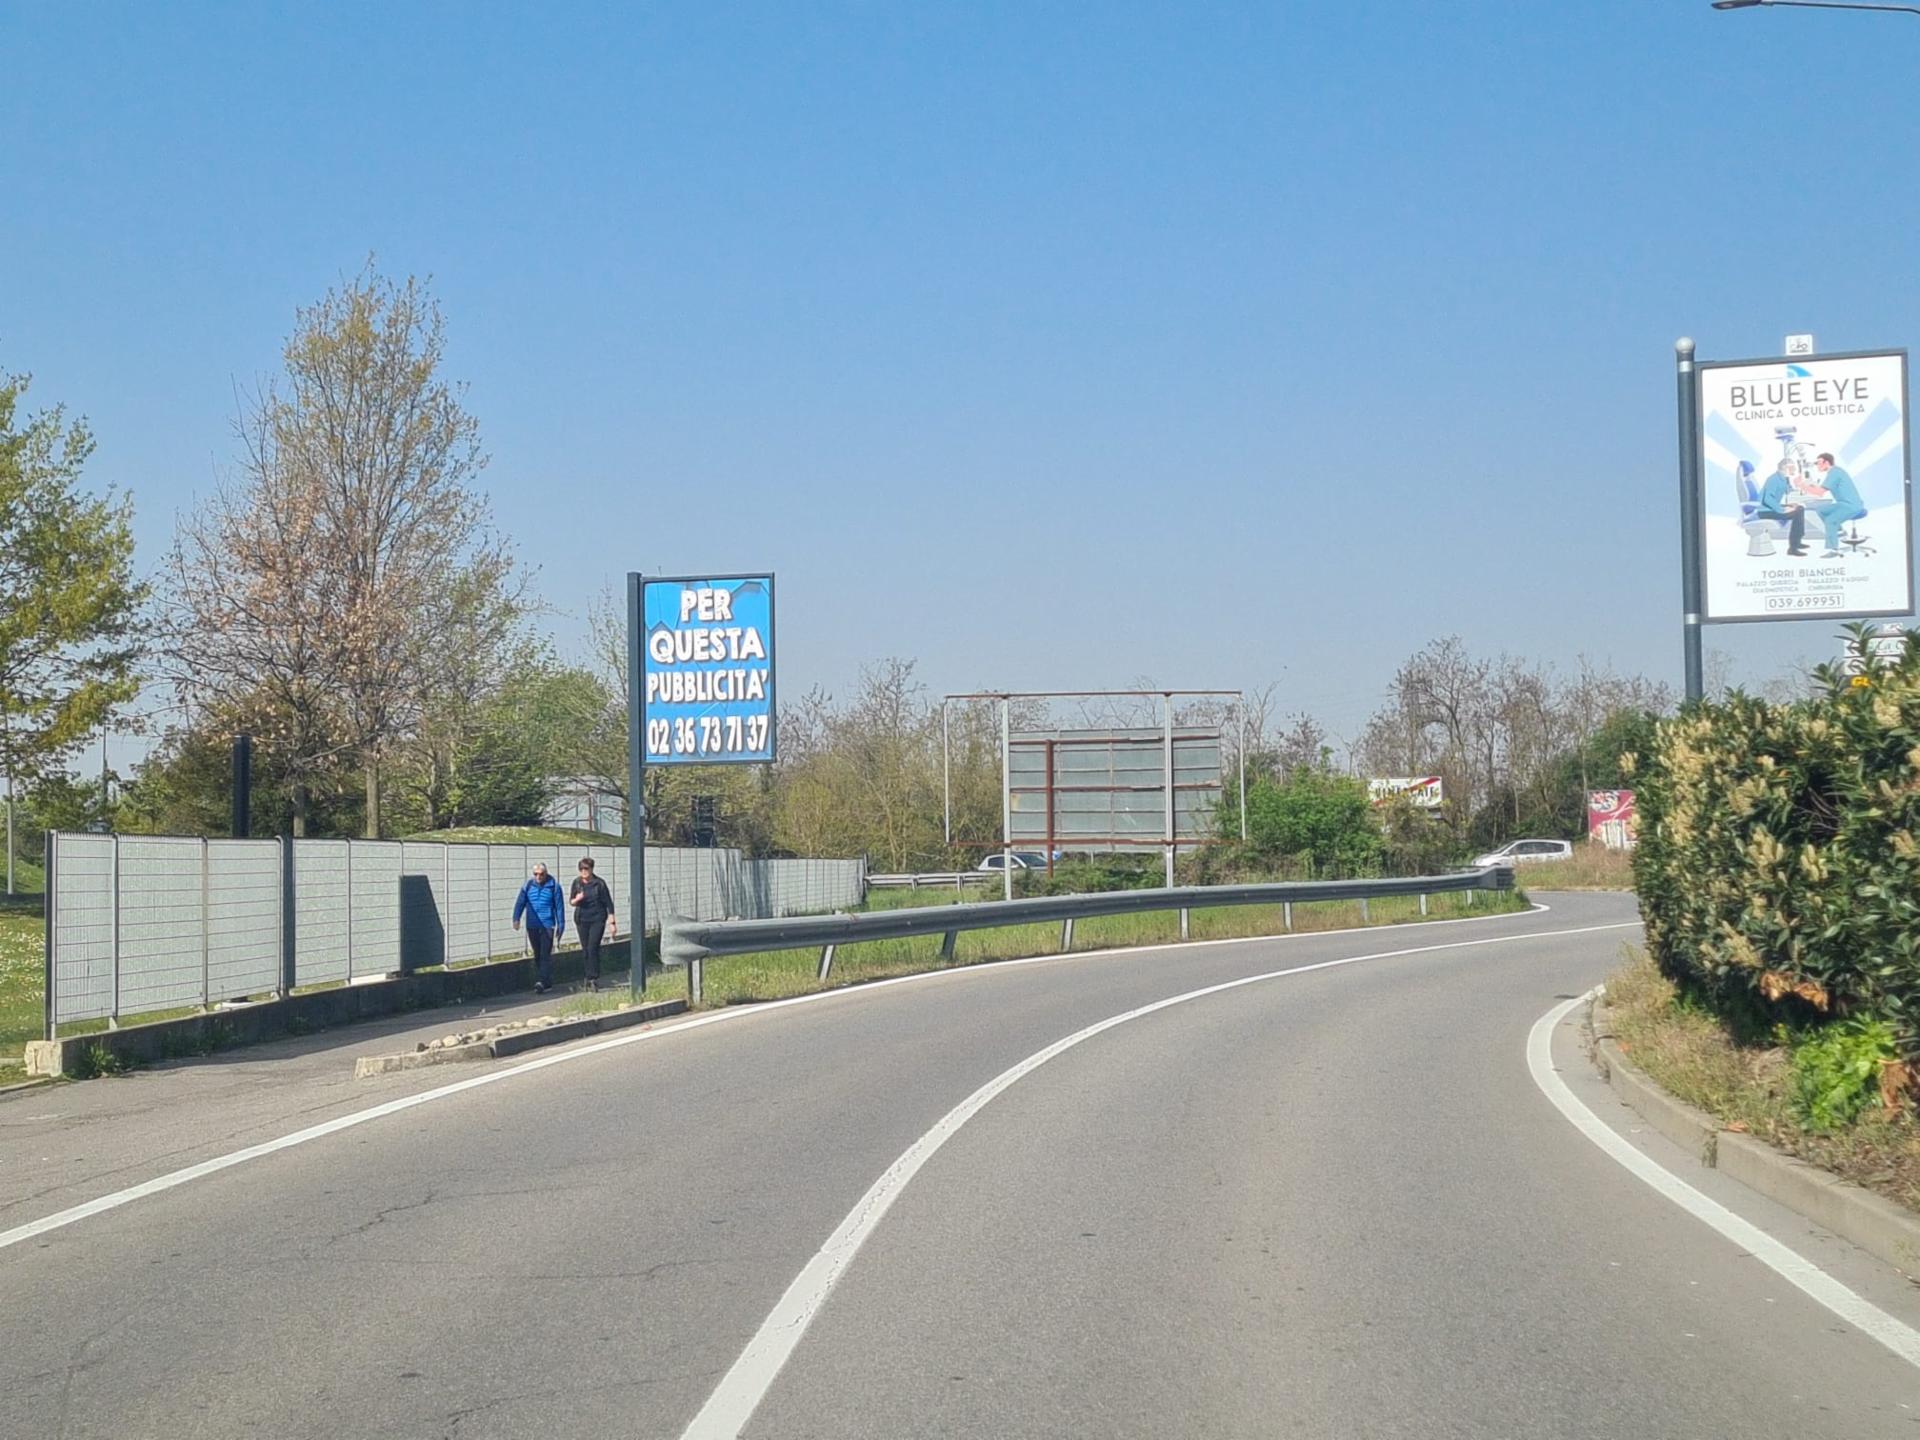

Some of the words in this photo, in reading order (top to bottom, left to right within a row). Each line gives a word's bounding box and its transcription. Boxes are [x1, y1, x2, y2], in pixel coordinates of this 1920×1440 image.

[1731, 382, 1802, 408] BLUE
[1813, 377, 1869, 402] EYE
[1735, 409, 1784, 420] CLINICA
[1790, 403, 1865, 417] OCULISTICA
[1762, 569, 1794, 579] TORRI
[1799, 567, 1846, 578] BIANCHE
[680, 588, 733, 622] PER
[1768, 595, 1841, 608] 039.699951
[650, 627, 766, 664] QUESTA
[647, 668, 768, 703] PUBBLICITA'
[648, 719, 670, 754] 02
[674, 717, 696, 753] 36
[700, 716, 722, 753] 73
[726, 715, 743, 752] 71
[747, 715, 768, 751] 37
